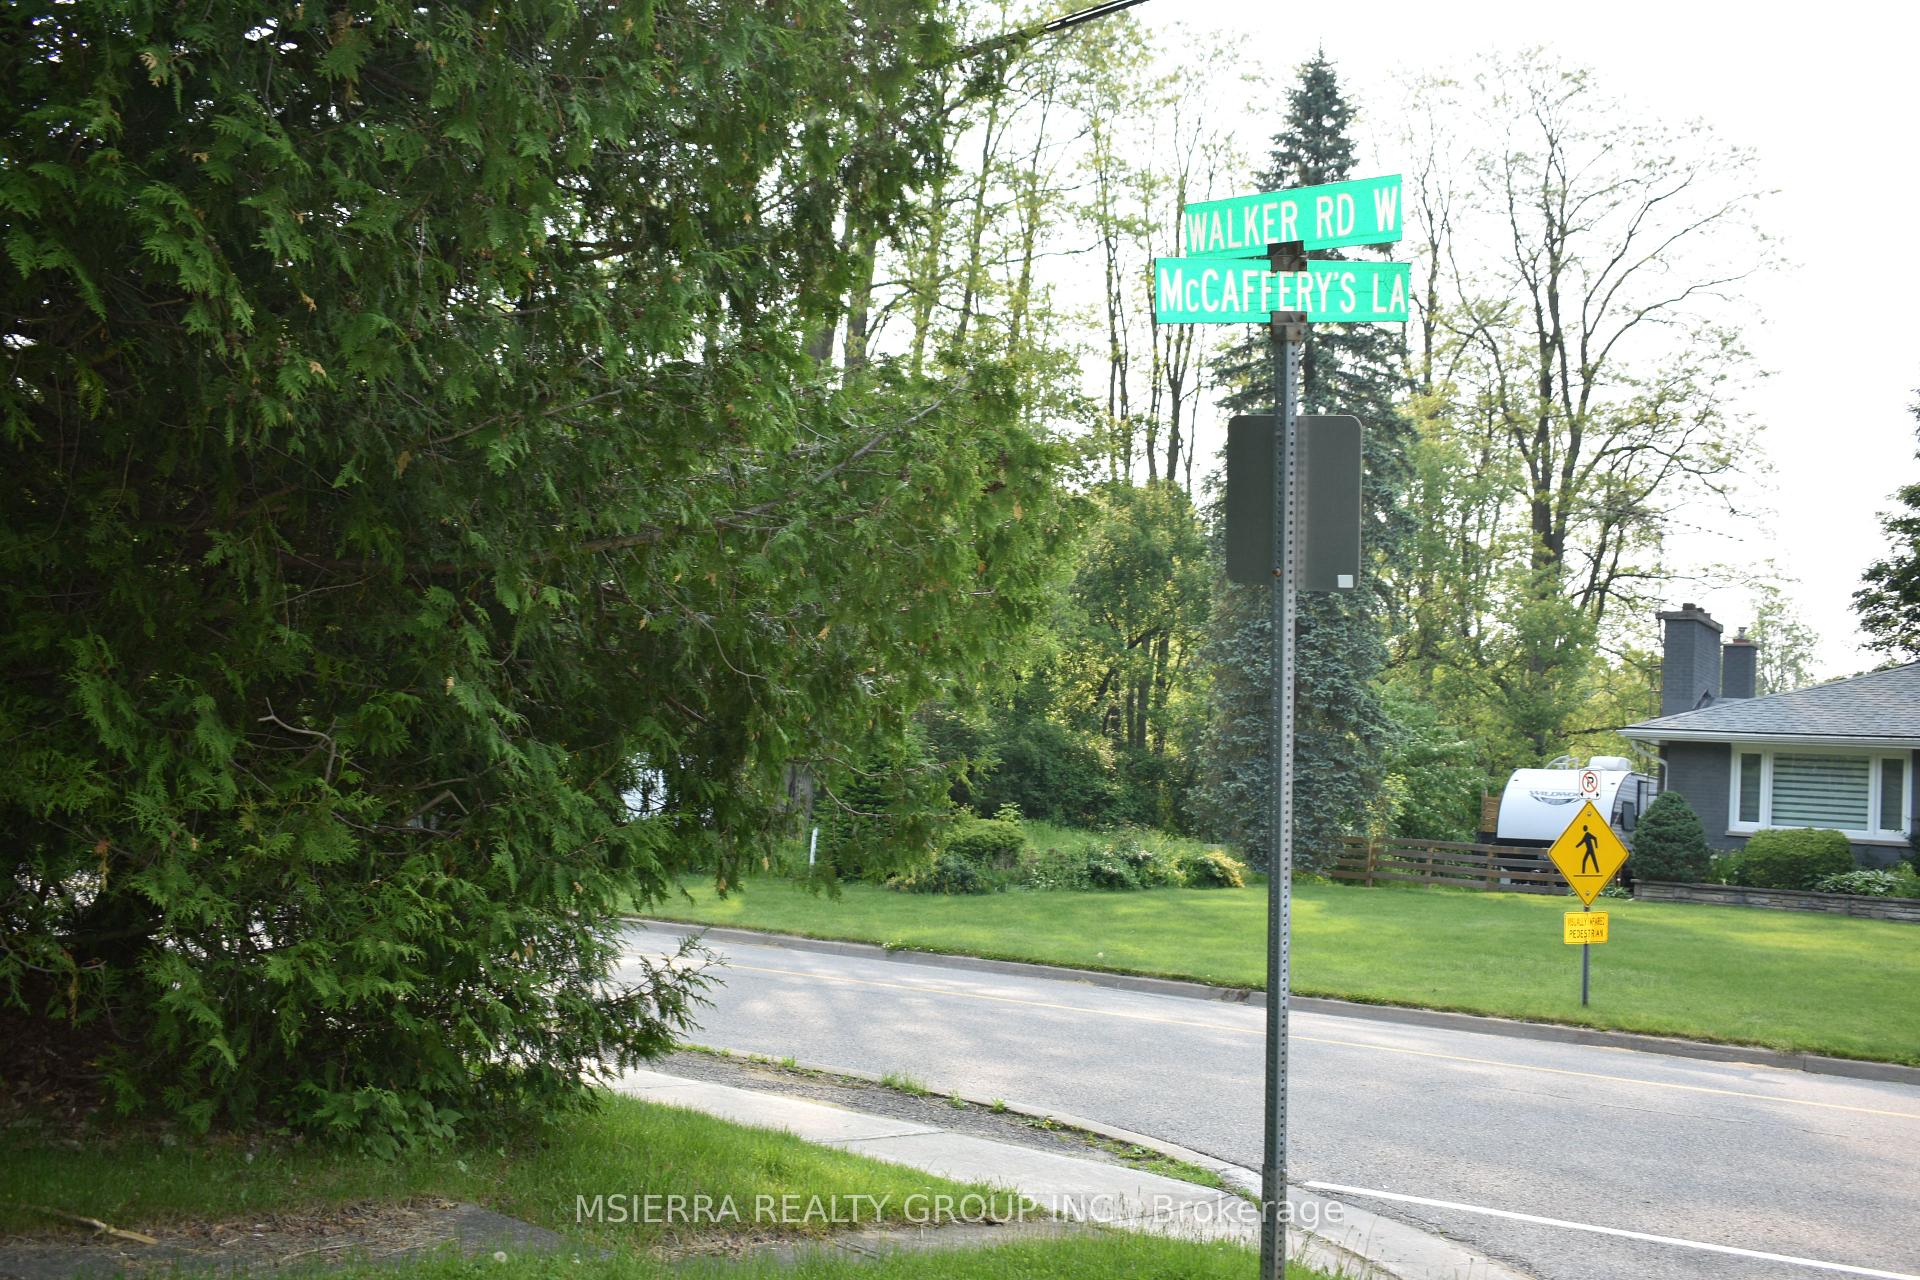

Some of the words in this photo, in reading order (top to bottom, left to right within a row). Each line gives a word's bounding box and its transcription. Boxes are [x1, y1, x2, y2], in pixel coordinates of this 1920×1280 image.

[1188, 200, 1298, 252] WALKER
[1316, 193, 1355, 239] RD
[1373, 186, 1398, 232] W
[1372, 272, 1406, 313] LA
